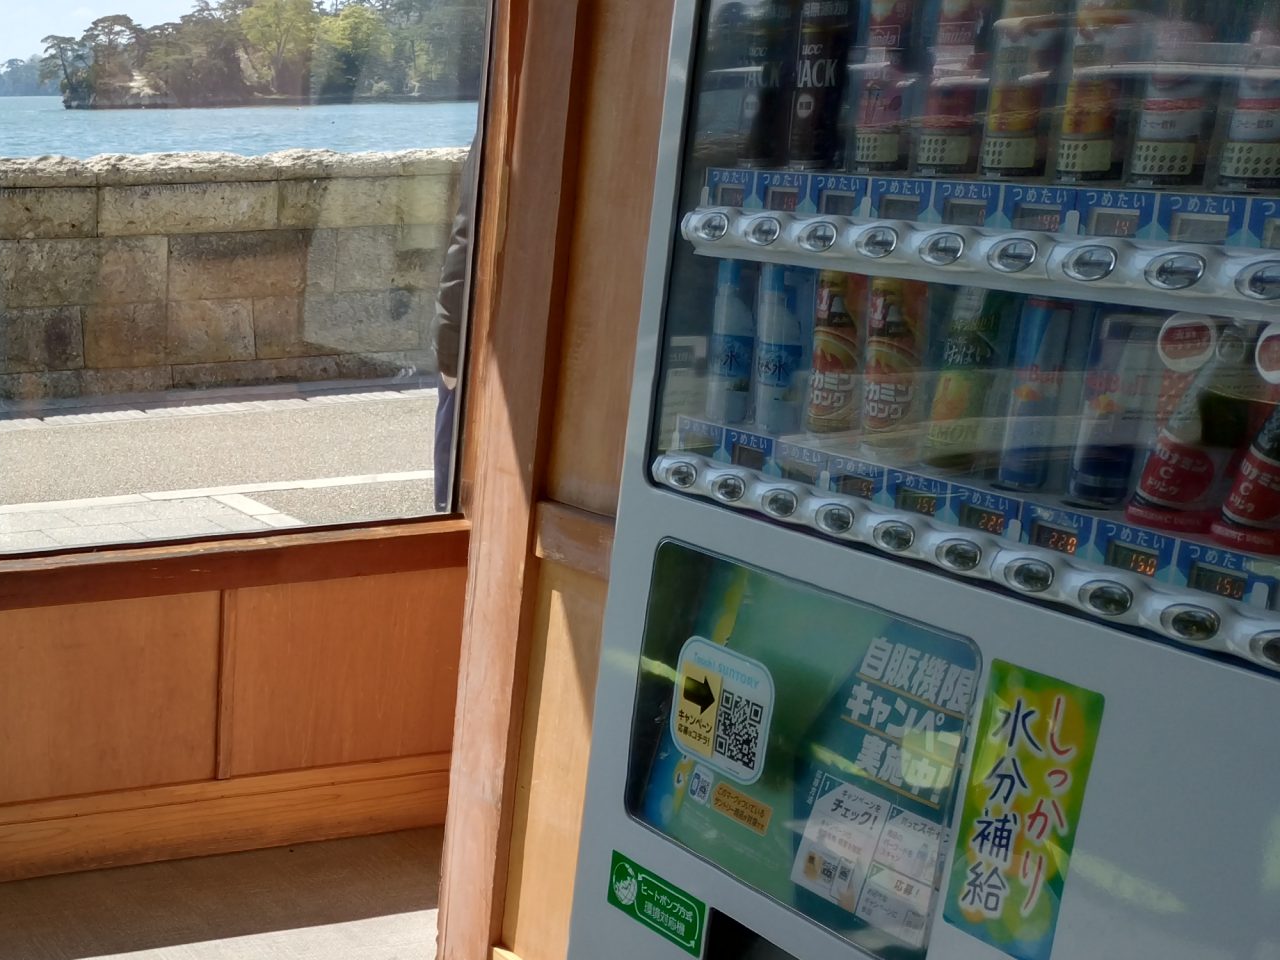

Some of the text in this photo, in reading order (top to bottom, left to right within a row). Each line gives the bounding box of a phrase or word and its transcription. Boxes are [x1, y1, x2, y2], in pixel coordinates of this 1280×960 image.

[713, 171, 749, 182] つめたい
[763, 173, 802, 186] つめたい
[817, 176, 860, 190] つめたい
[878, 180, 925, 194] つめたい
[942, 184, 992, 199] つめたい
[1013, 188, 1067, 202] つめたい
[1086, 192, 1145, 208] つめたい
[1170, 196, 1236, 214] つめたい
[731, 432, 768, 449] つめたい
[836, 459, 877, 477] つめたい
[895, 472, 941, 493] つめたい
[958, 489, 1009, 510] つめたい
[1049, 532, 1077, 554] 220
[1106, 523, 1165, 549] つめたい
[1129, 554, 1157, 577] 150
[719, 663, 760, 689] SUNTORY
[678, 709, 713, 734] キャンペーン
[960, 698, 1043, 912] 水分補給
[1023, 697, 1073, 911] しっかり
[641, 882, 693, 923] ヒートポンプ方式
[644, 900, 685, 937] 環境対応機
